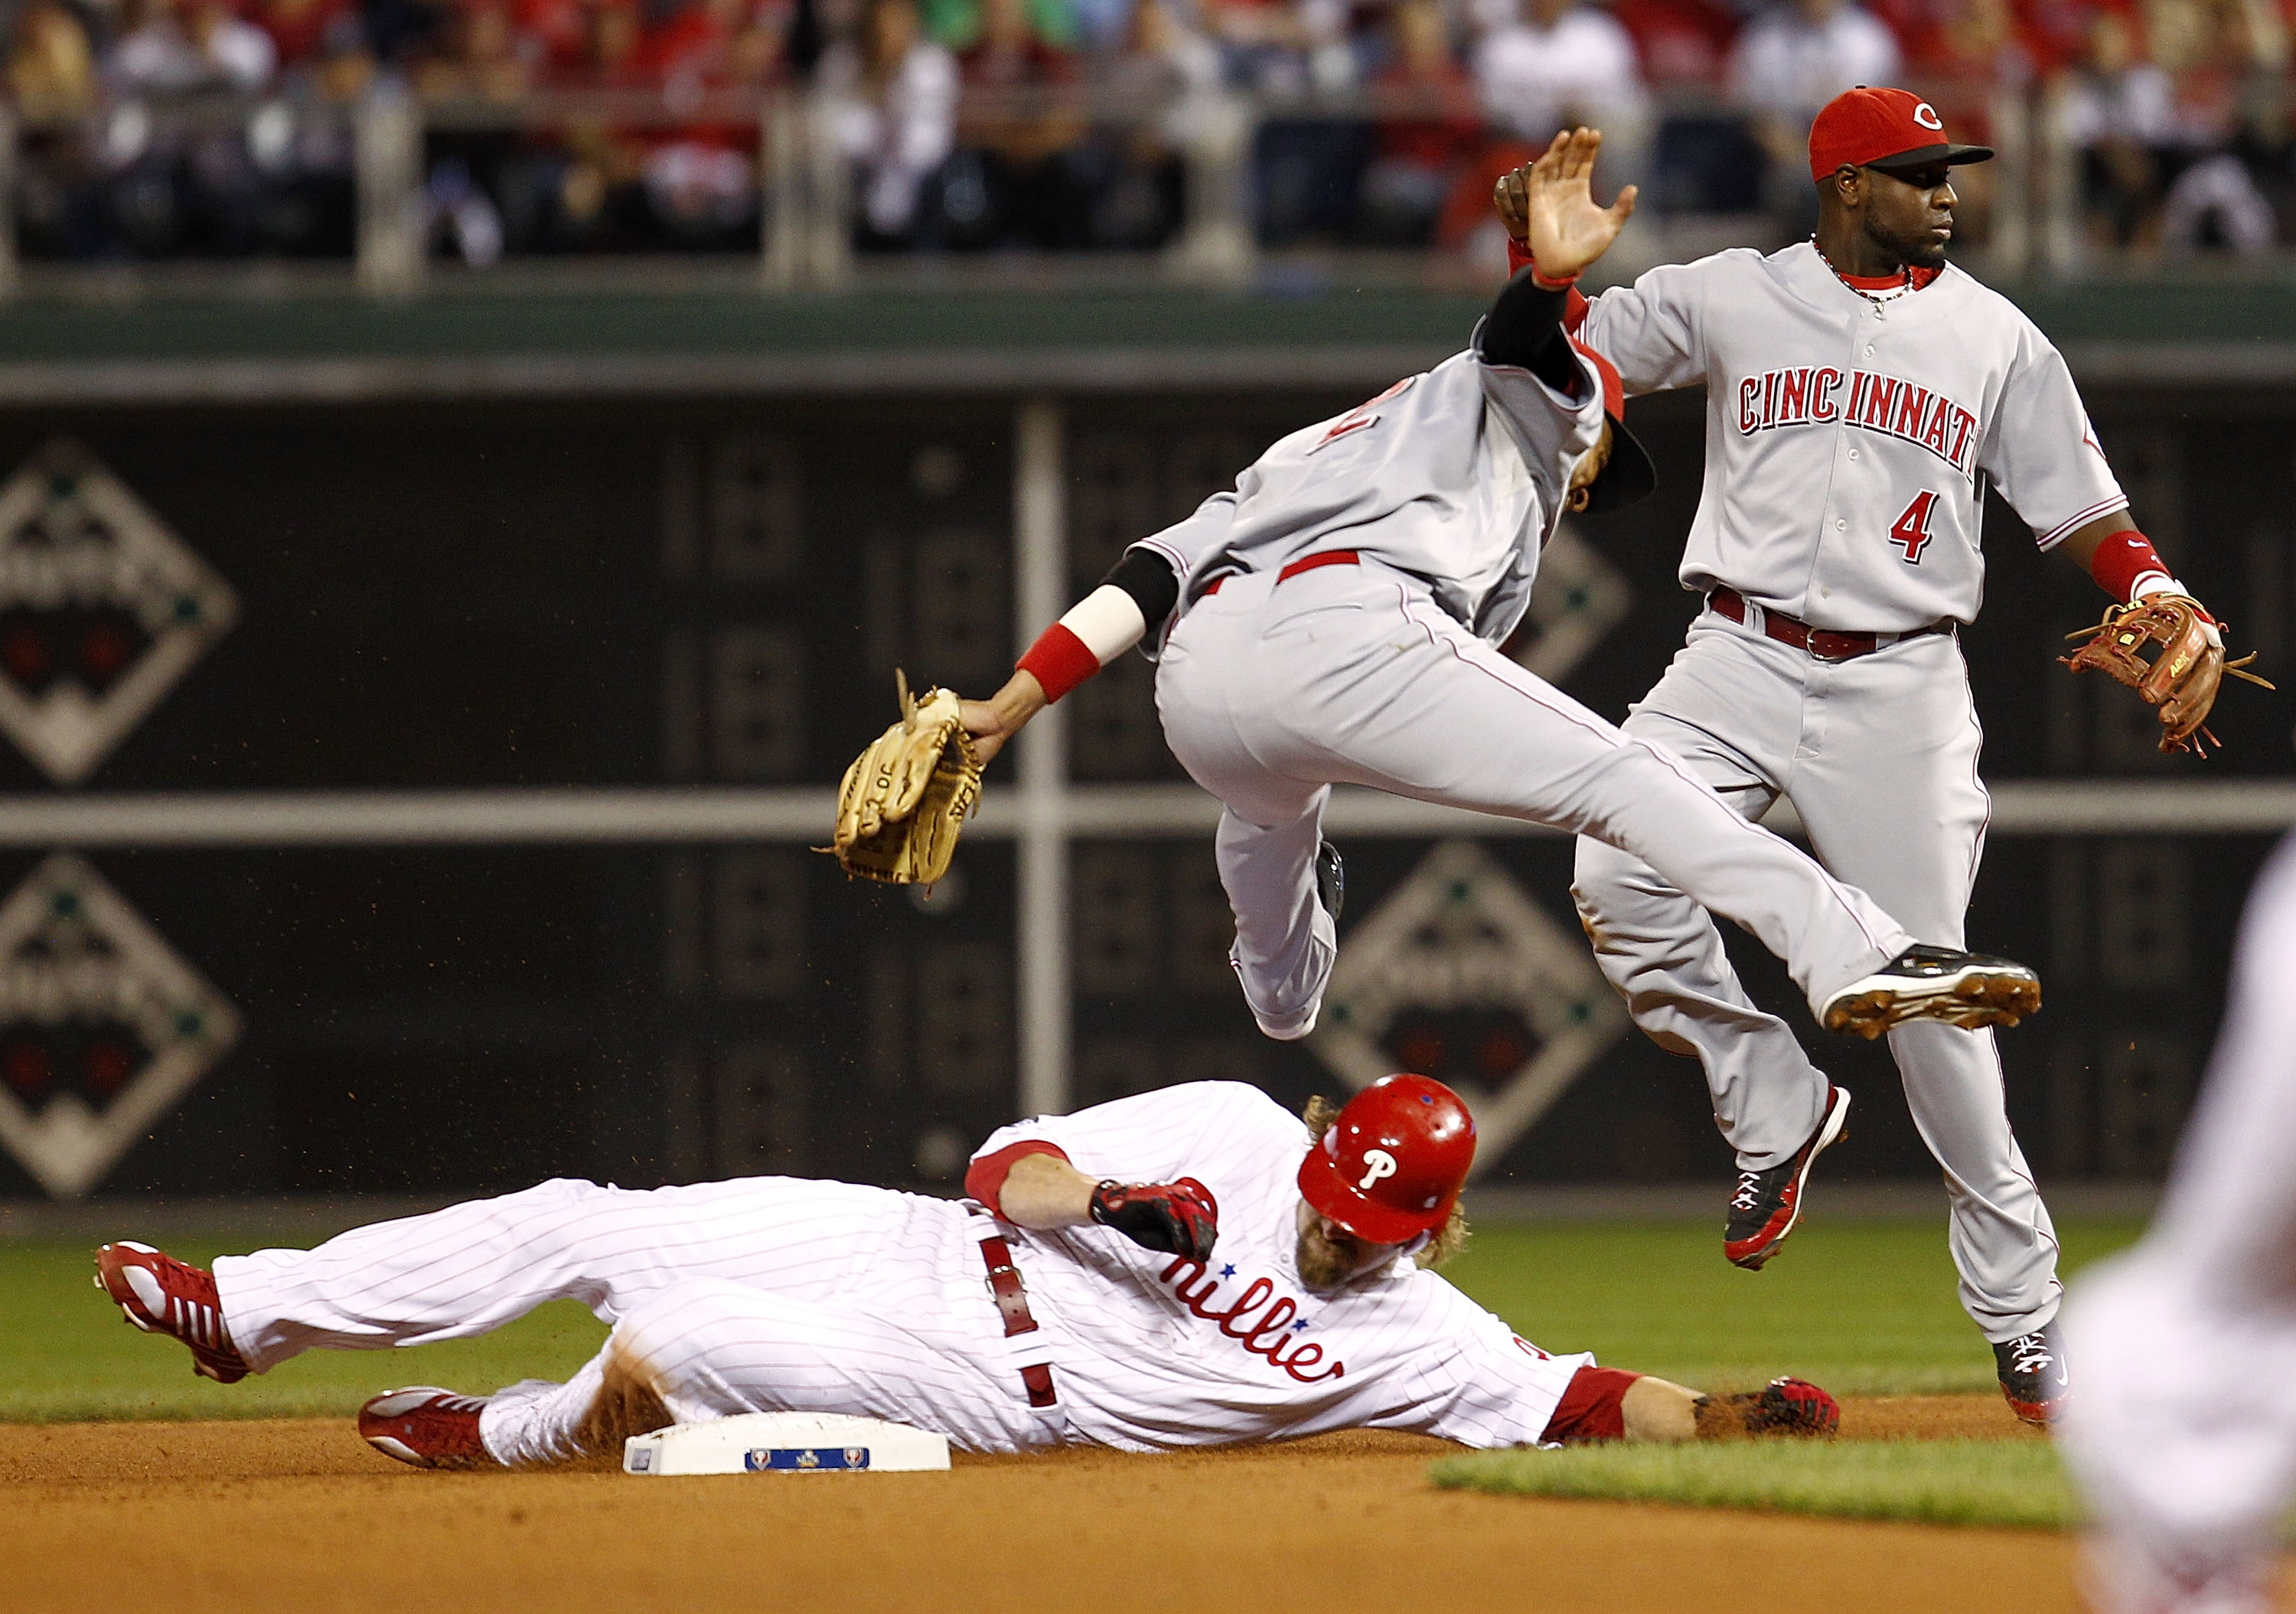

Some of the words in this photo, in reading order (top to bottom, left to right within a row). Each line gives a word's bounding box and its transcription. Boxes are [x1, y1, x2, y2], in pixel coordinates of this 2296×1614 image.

[1913, 102, 1943, 131] C
[1737, 365, 1979, 485] CINCINNAT
[1888, 488, 1940, 566] 4
[1358, 1148, 1398, 1191] P
